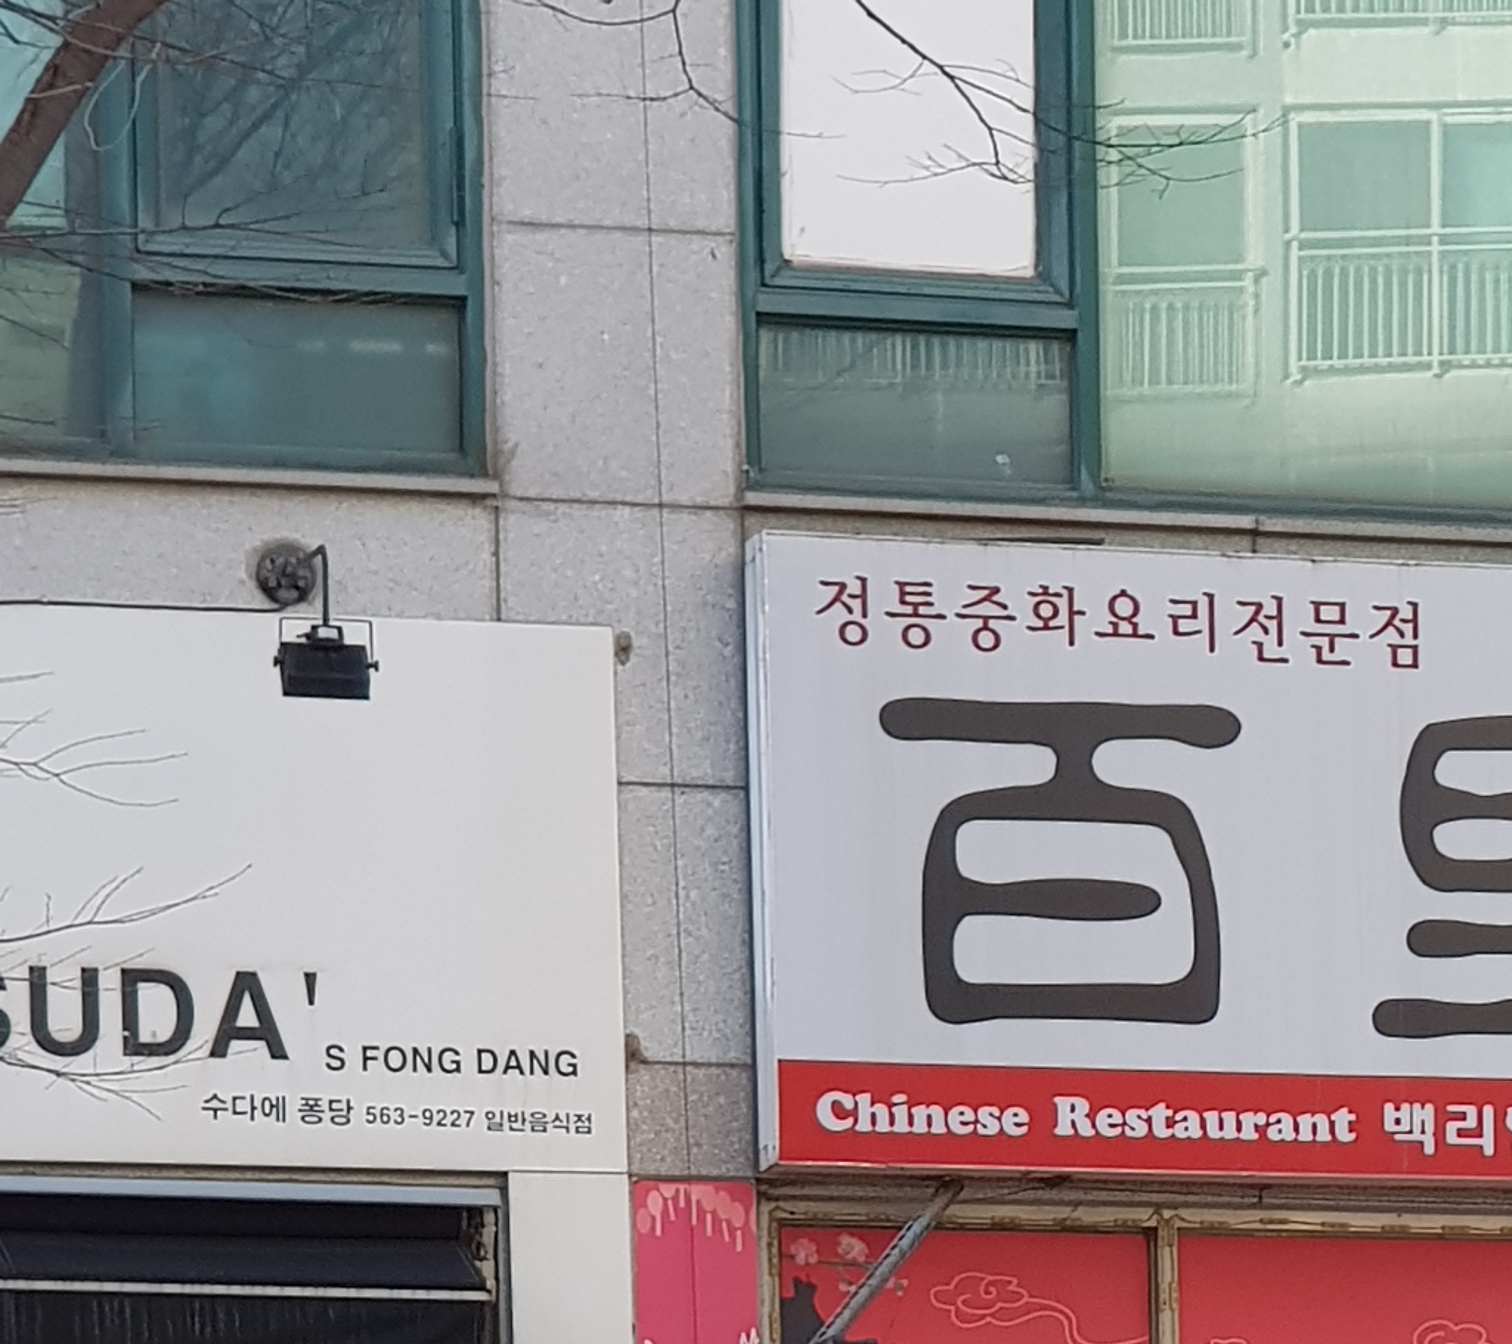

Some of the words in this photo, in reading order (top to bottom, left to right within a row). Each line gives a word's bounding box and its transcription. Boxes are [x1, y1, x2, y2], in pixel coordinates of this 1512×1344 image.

[815, 574, 1422, 670] 정통중화요리전문점
[0, 963, 319, 1061] UDA'
[361, 1045, 463, 1076] FONG
[476, 1047, 580, 1078] DANG
[199, 1092, 288, 1126] 수다에
[296, 1095, 355, 1127] 퐁당
[364, 1105, 477, 1131] 563-9227
[484, 1109, 594, 1136] 일반음식점
[814, 1090, 1029, 1137] Chinese
[1052, 1096, 1357, 1145] Restaurant
